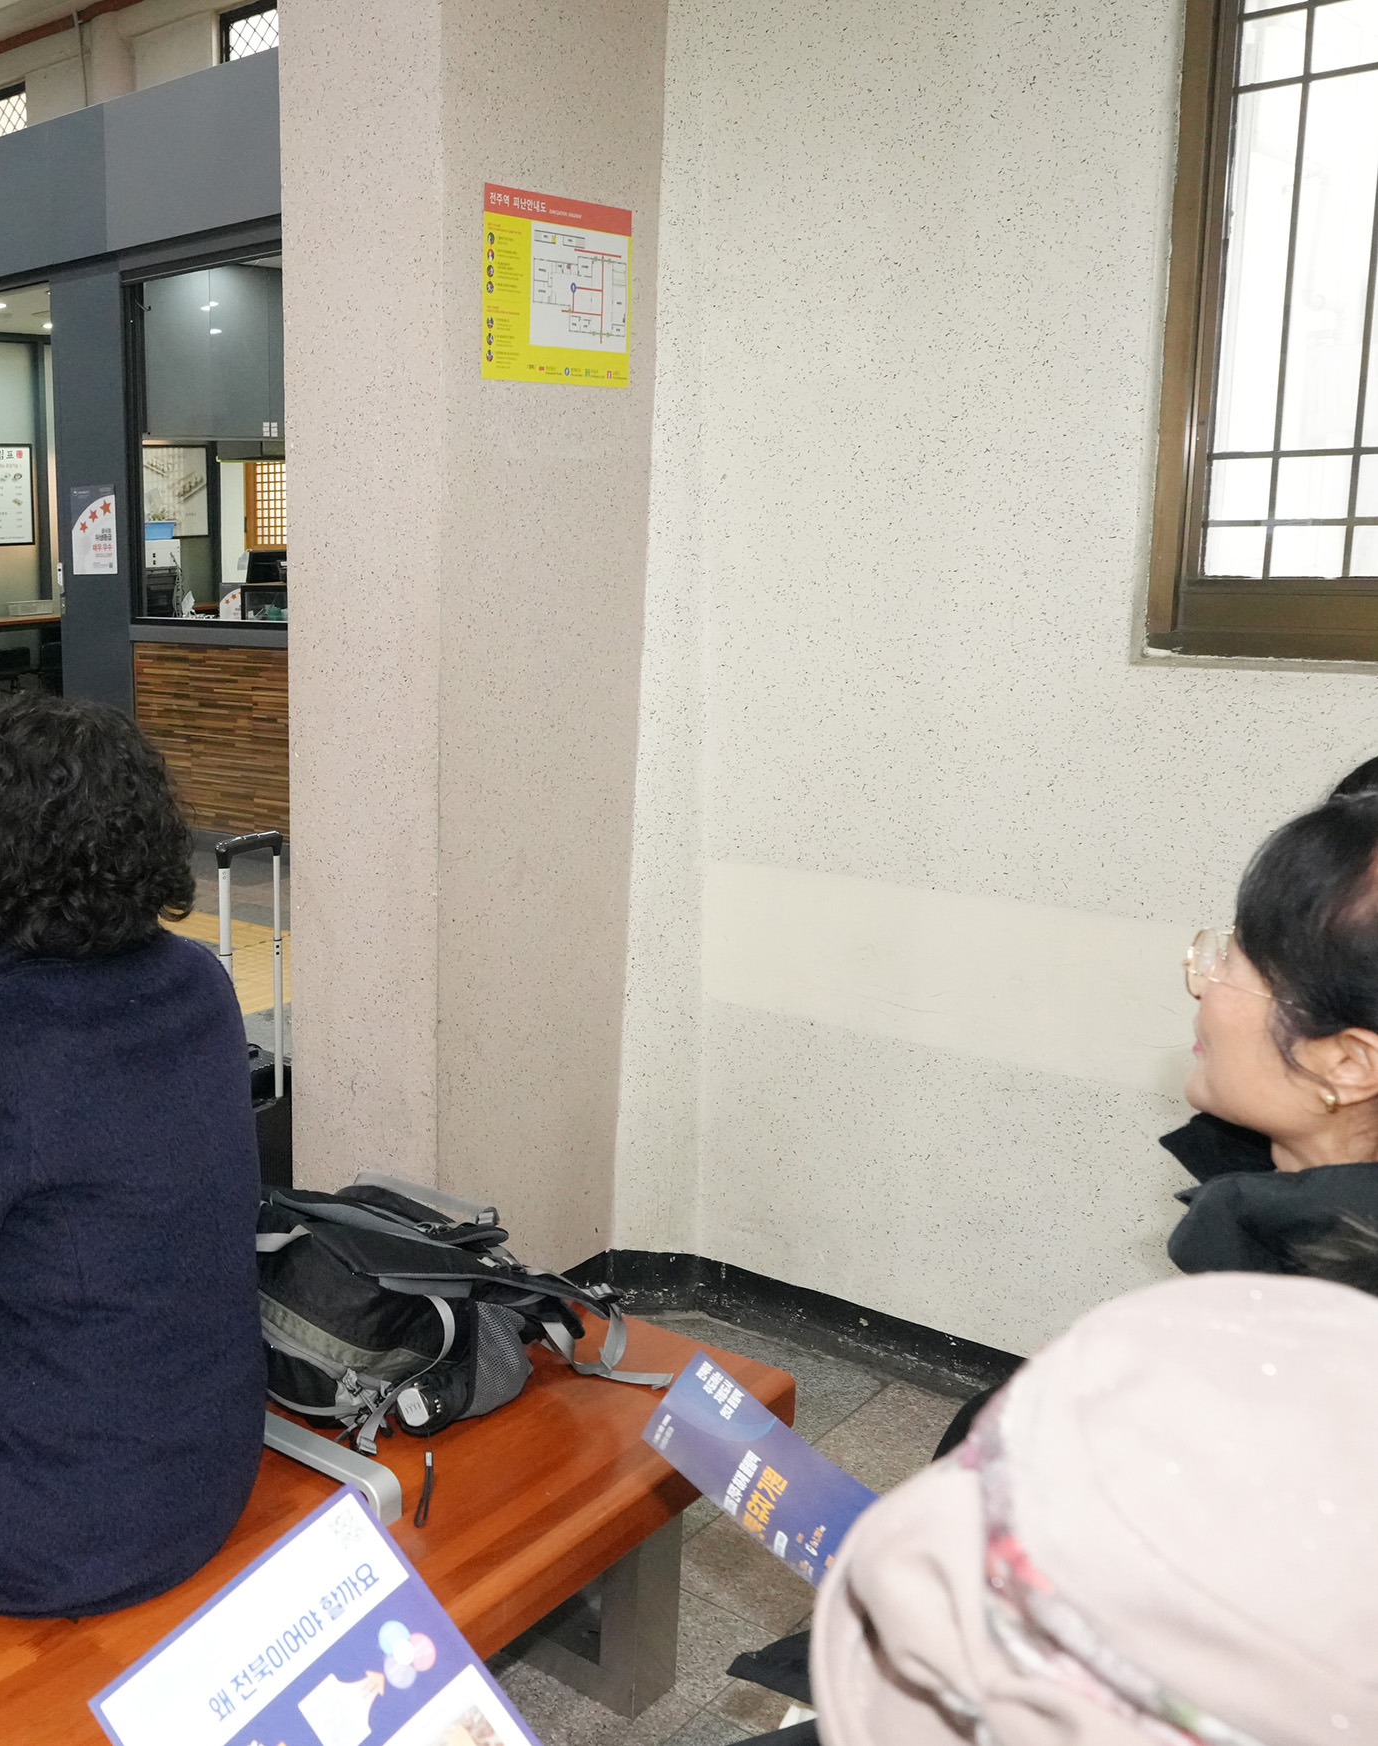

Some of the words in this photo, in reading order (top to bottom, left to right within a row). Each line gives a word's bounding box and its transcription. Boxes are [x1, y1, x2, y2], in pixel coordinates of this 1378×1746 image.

[489, 191, 511, 207] 전주역
[513, 196, 547, 213] 피난안내도
[756, 1465, 788, 1502] 기원
[746, 1489, 776, 1525] 유치
[208, 1688, 236, 1722] 왜
[230, 1609, 324, 1702] 전북이어야
[319, 1563, 380, 1621] 할까요
